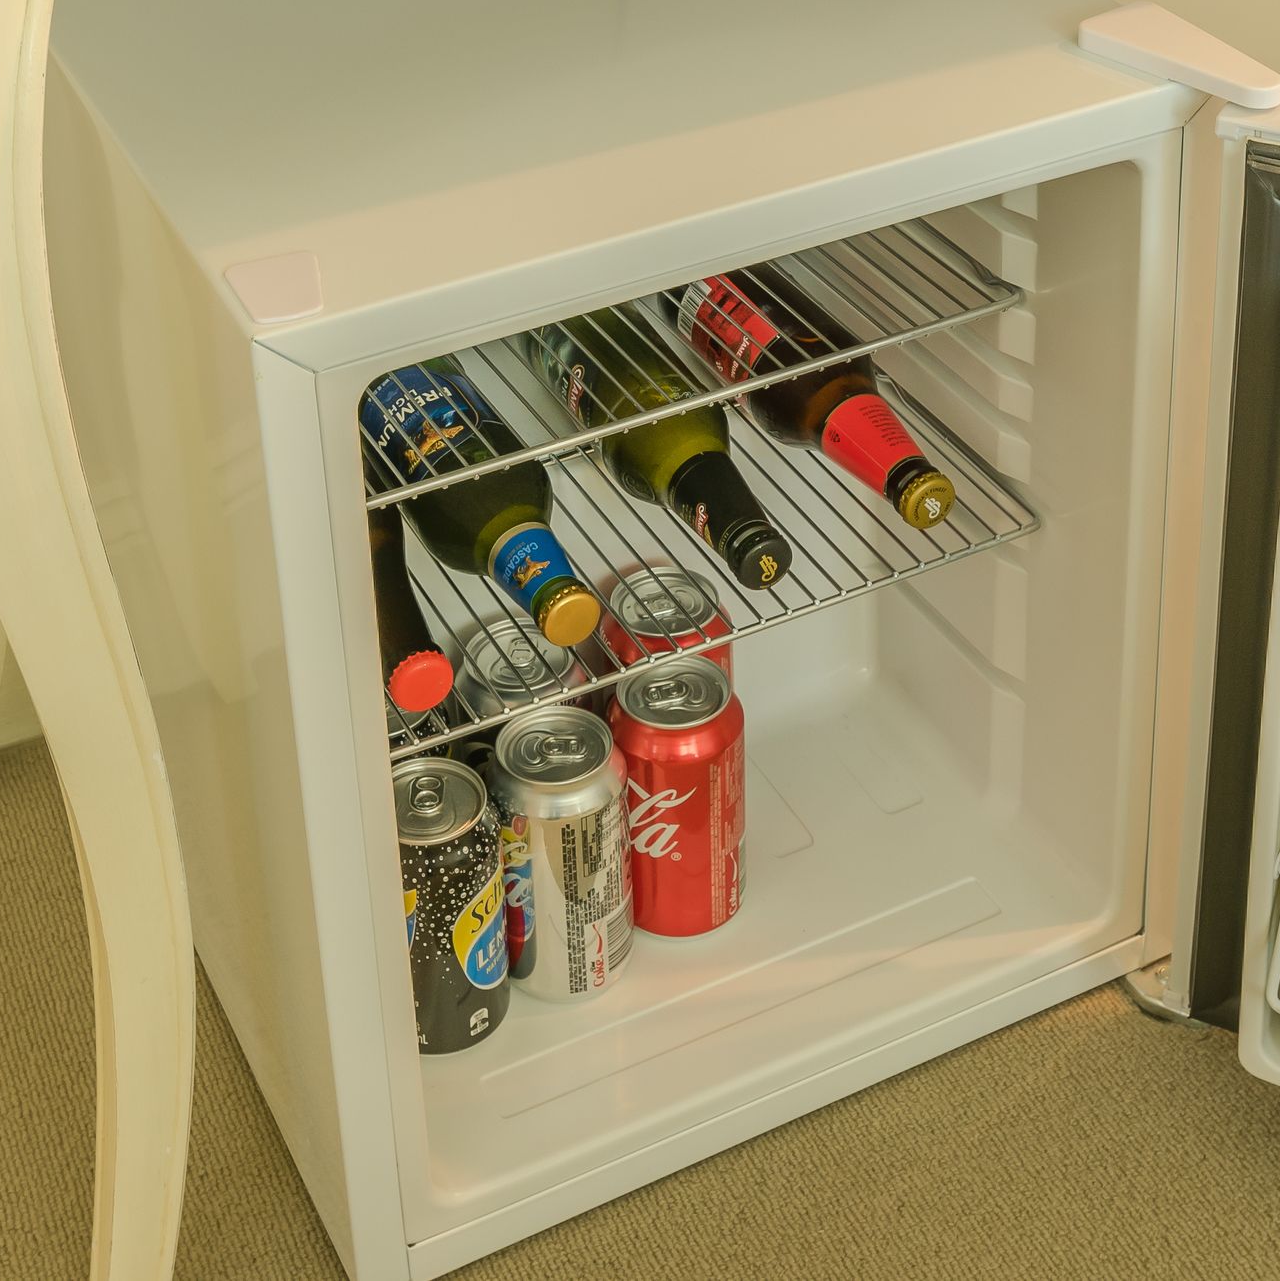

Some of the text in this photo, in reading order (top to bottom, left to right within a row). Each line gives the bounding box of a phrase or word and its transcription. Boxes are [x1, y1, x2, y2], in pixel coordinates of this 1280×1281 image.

[736, 335, 750, 356] JAME
[377, 387, 452, 449] PREMUM
[503, 542, 538, 583] CASCADE
[594, 959, 605, 987] Coke
